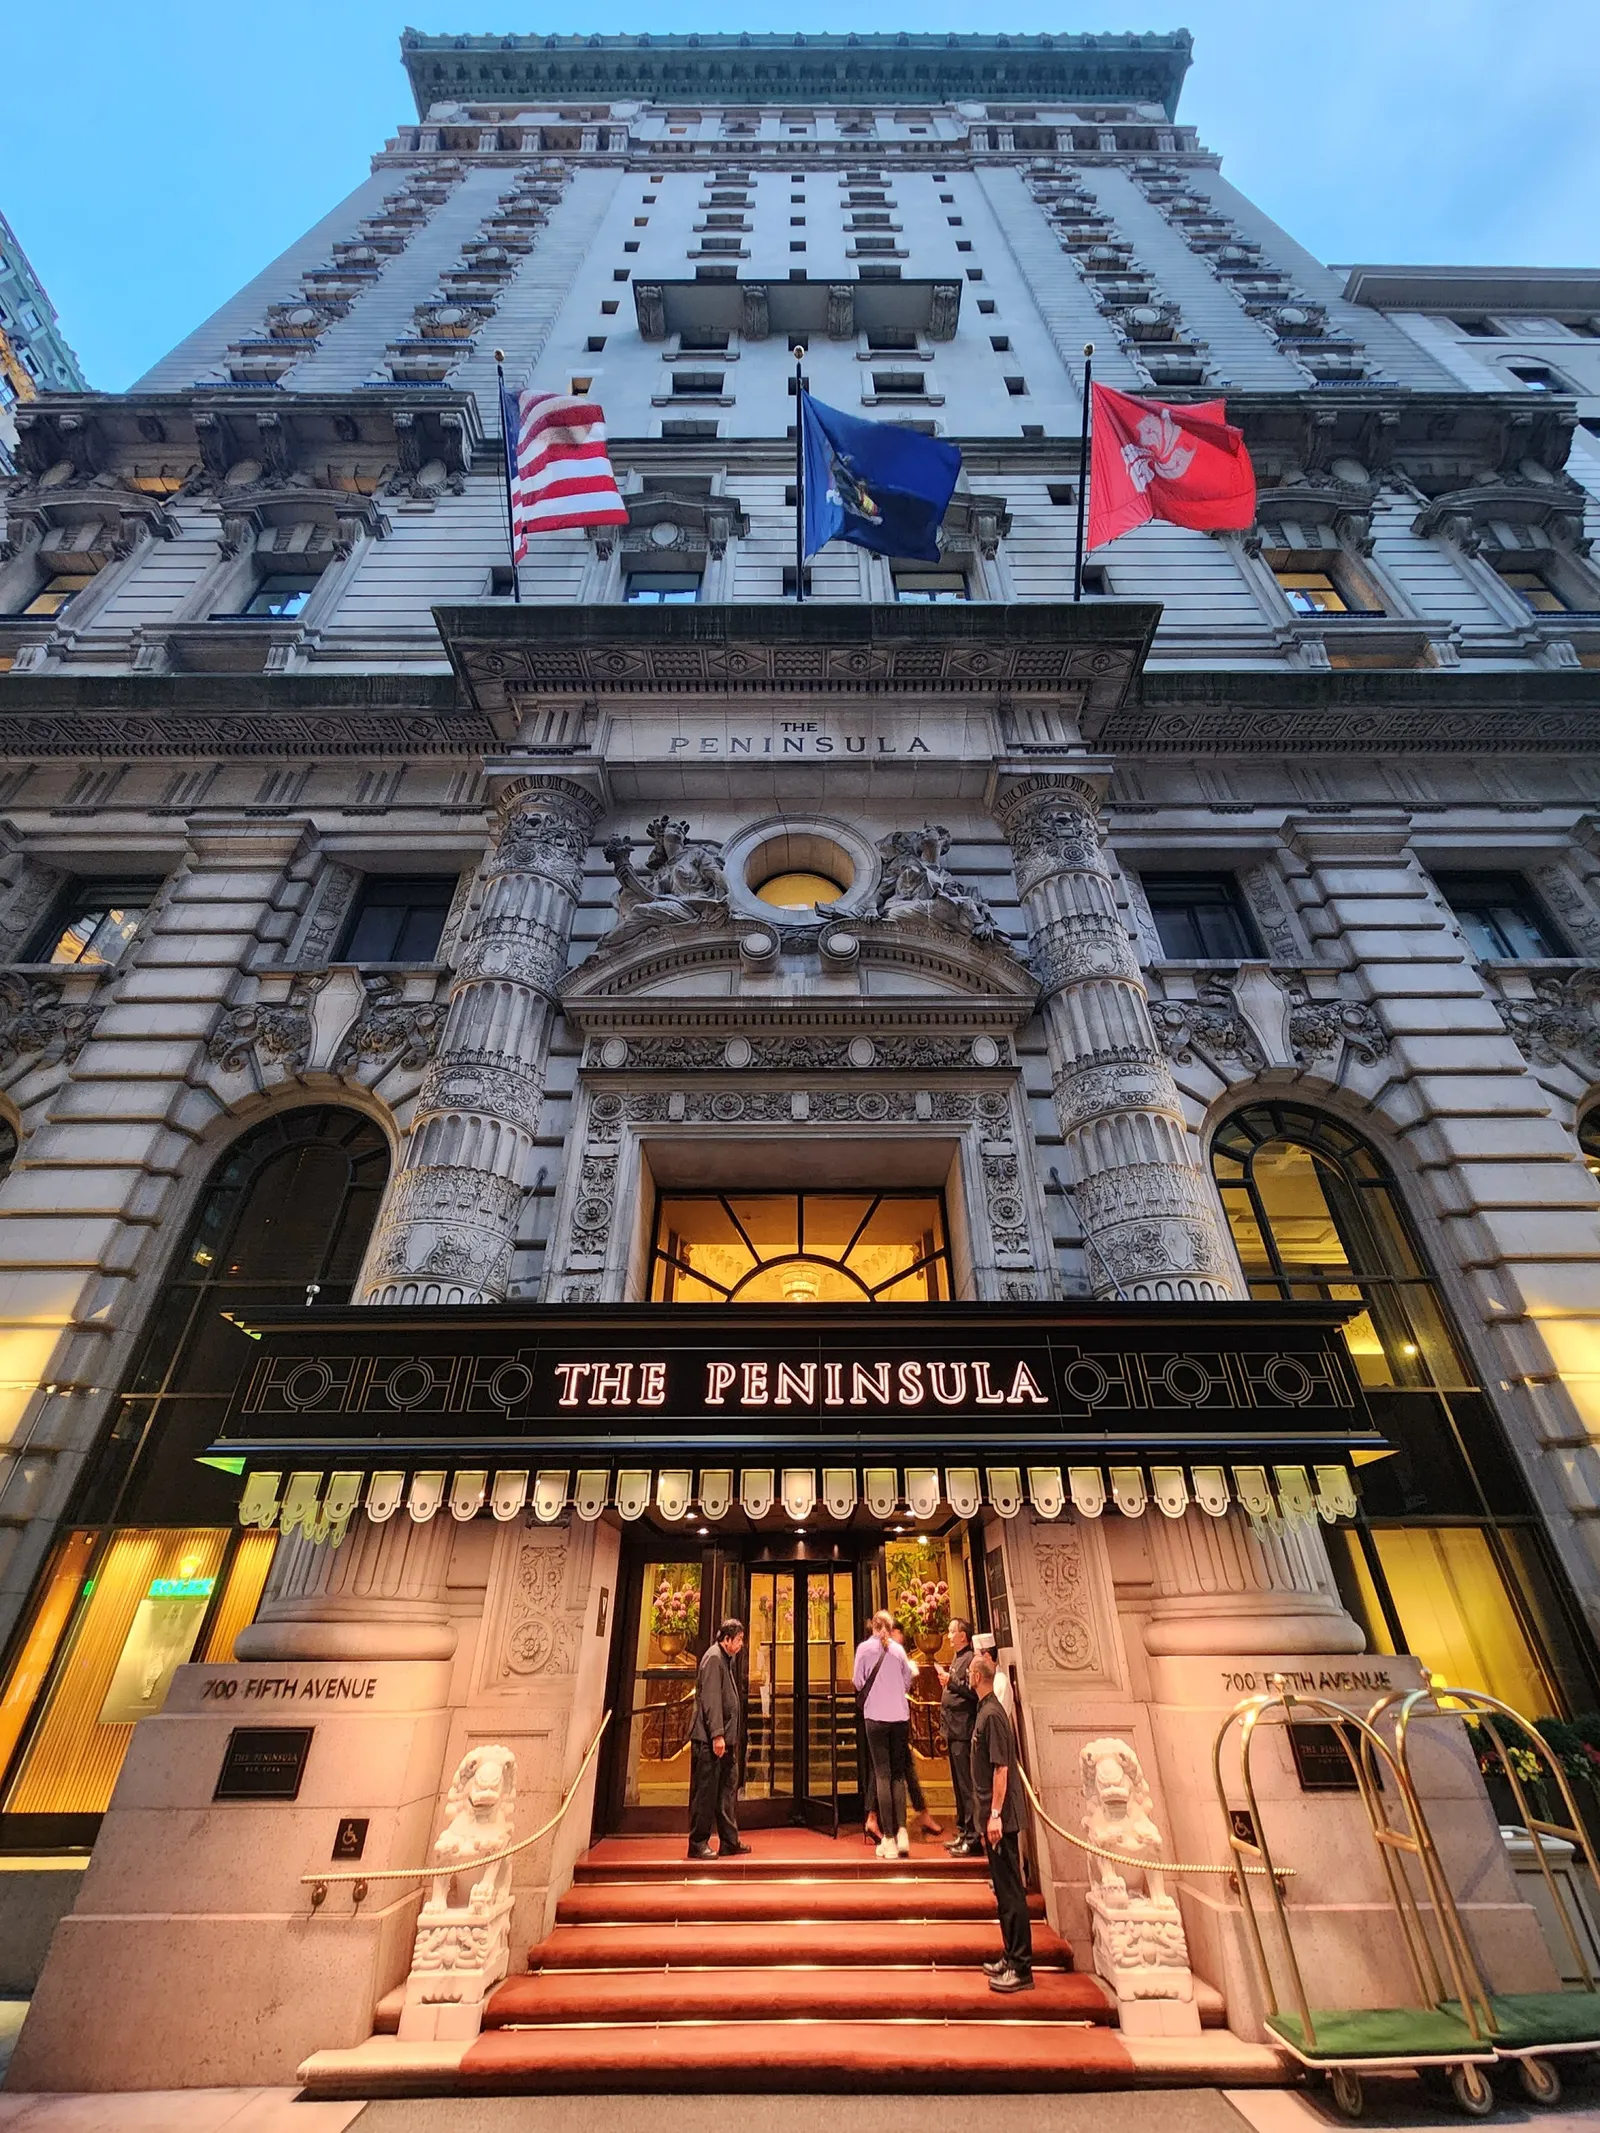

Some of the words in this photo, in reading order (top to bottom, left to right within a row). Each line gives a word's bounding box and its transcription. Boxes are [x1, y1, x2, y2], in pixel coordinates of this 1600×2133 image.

[780, 722, 818, 732] THE
[668, 736, 931, 753] PENINSULA
[554, 1362, 668, 1406] THE
[705, 1361, 1050, 1406] PENINSULA
[149, 1578, 213, 1596] ROLEX
[203, 1679, 238, 1699] 700
[244, 1678, 298, 1699] FIFTH
[300, 1678, 377, 1699] AVENUE
[1221, 1672, 1257, 1692] 700
[1262, 1671, 1317, 1692] FTH
[1318, 1671, 1392, 1692] AVENUE
